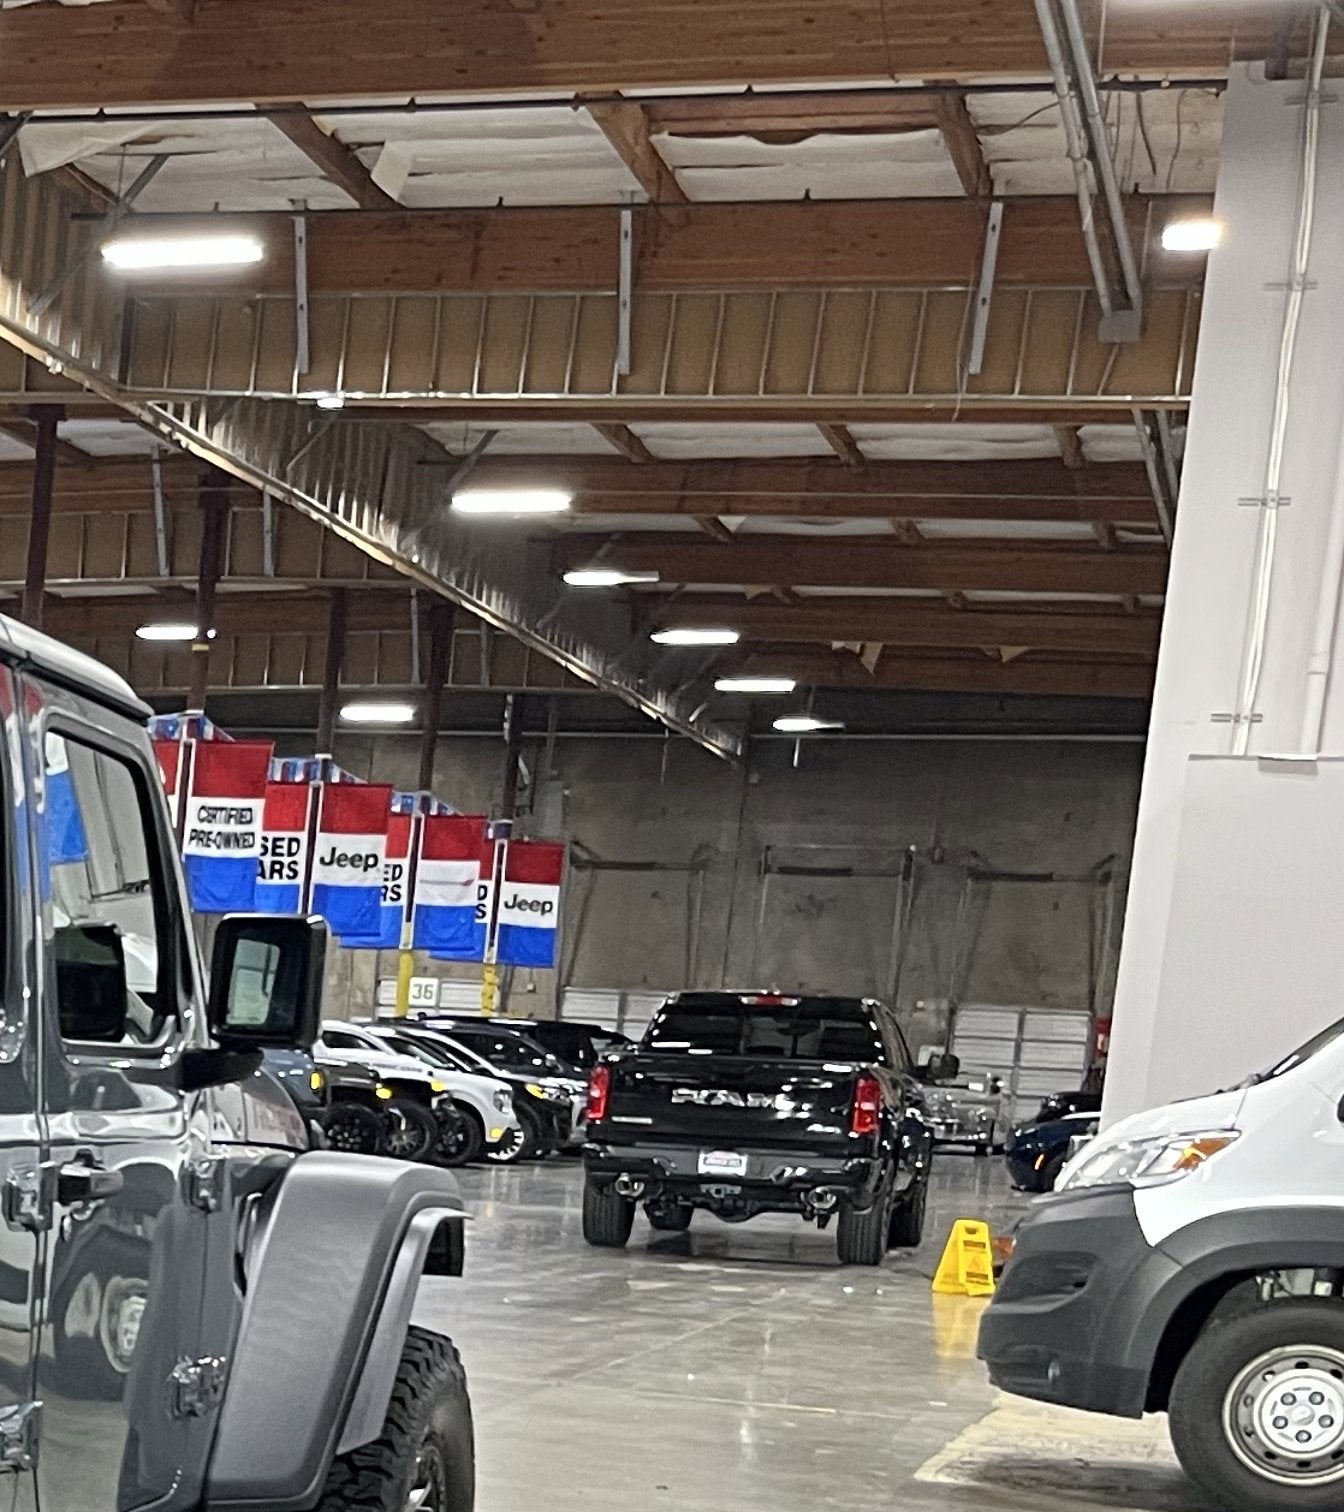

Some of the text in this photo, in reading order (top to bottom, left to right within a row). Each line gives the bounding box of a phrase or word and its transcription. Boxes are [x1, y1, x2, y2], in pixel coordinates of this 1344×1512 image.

[188, 828, 256, 850] PRE-OWNED
[261, 836, 301, 858] SED
[319, 846, 379, 872] Jeep
[257, 860, 300, 881] ARS
[504, 893, 554, 916] Jeep
[412, 983, 434, 1000] 36
